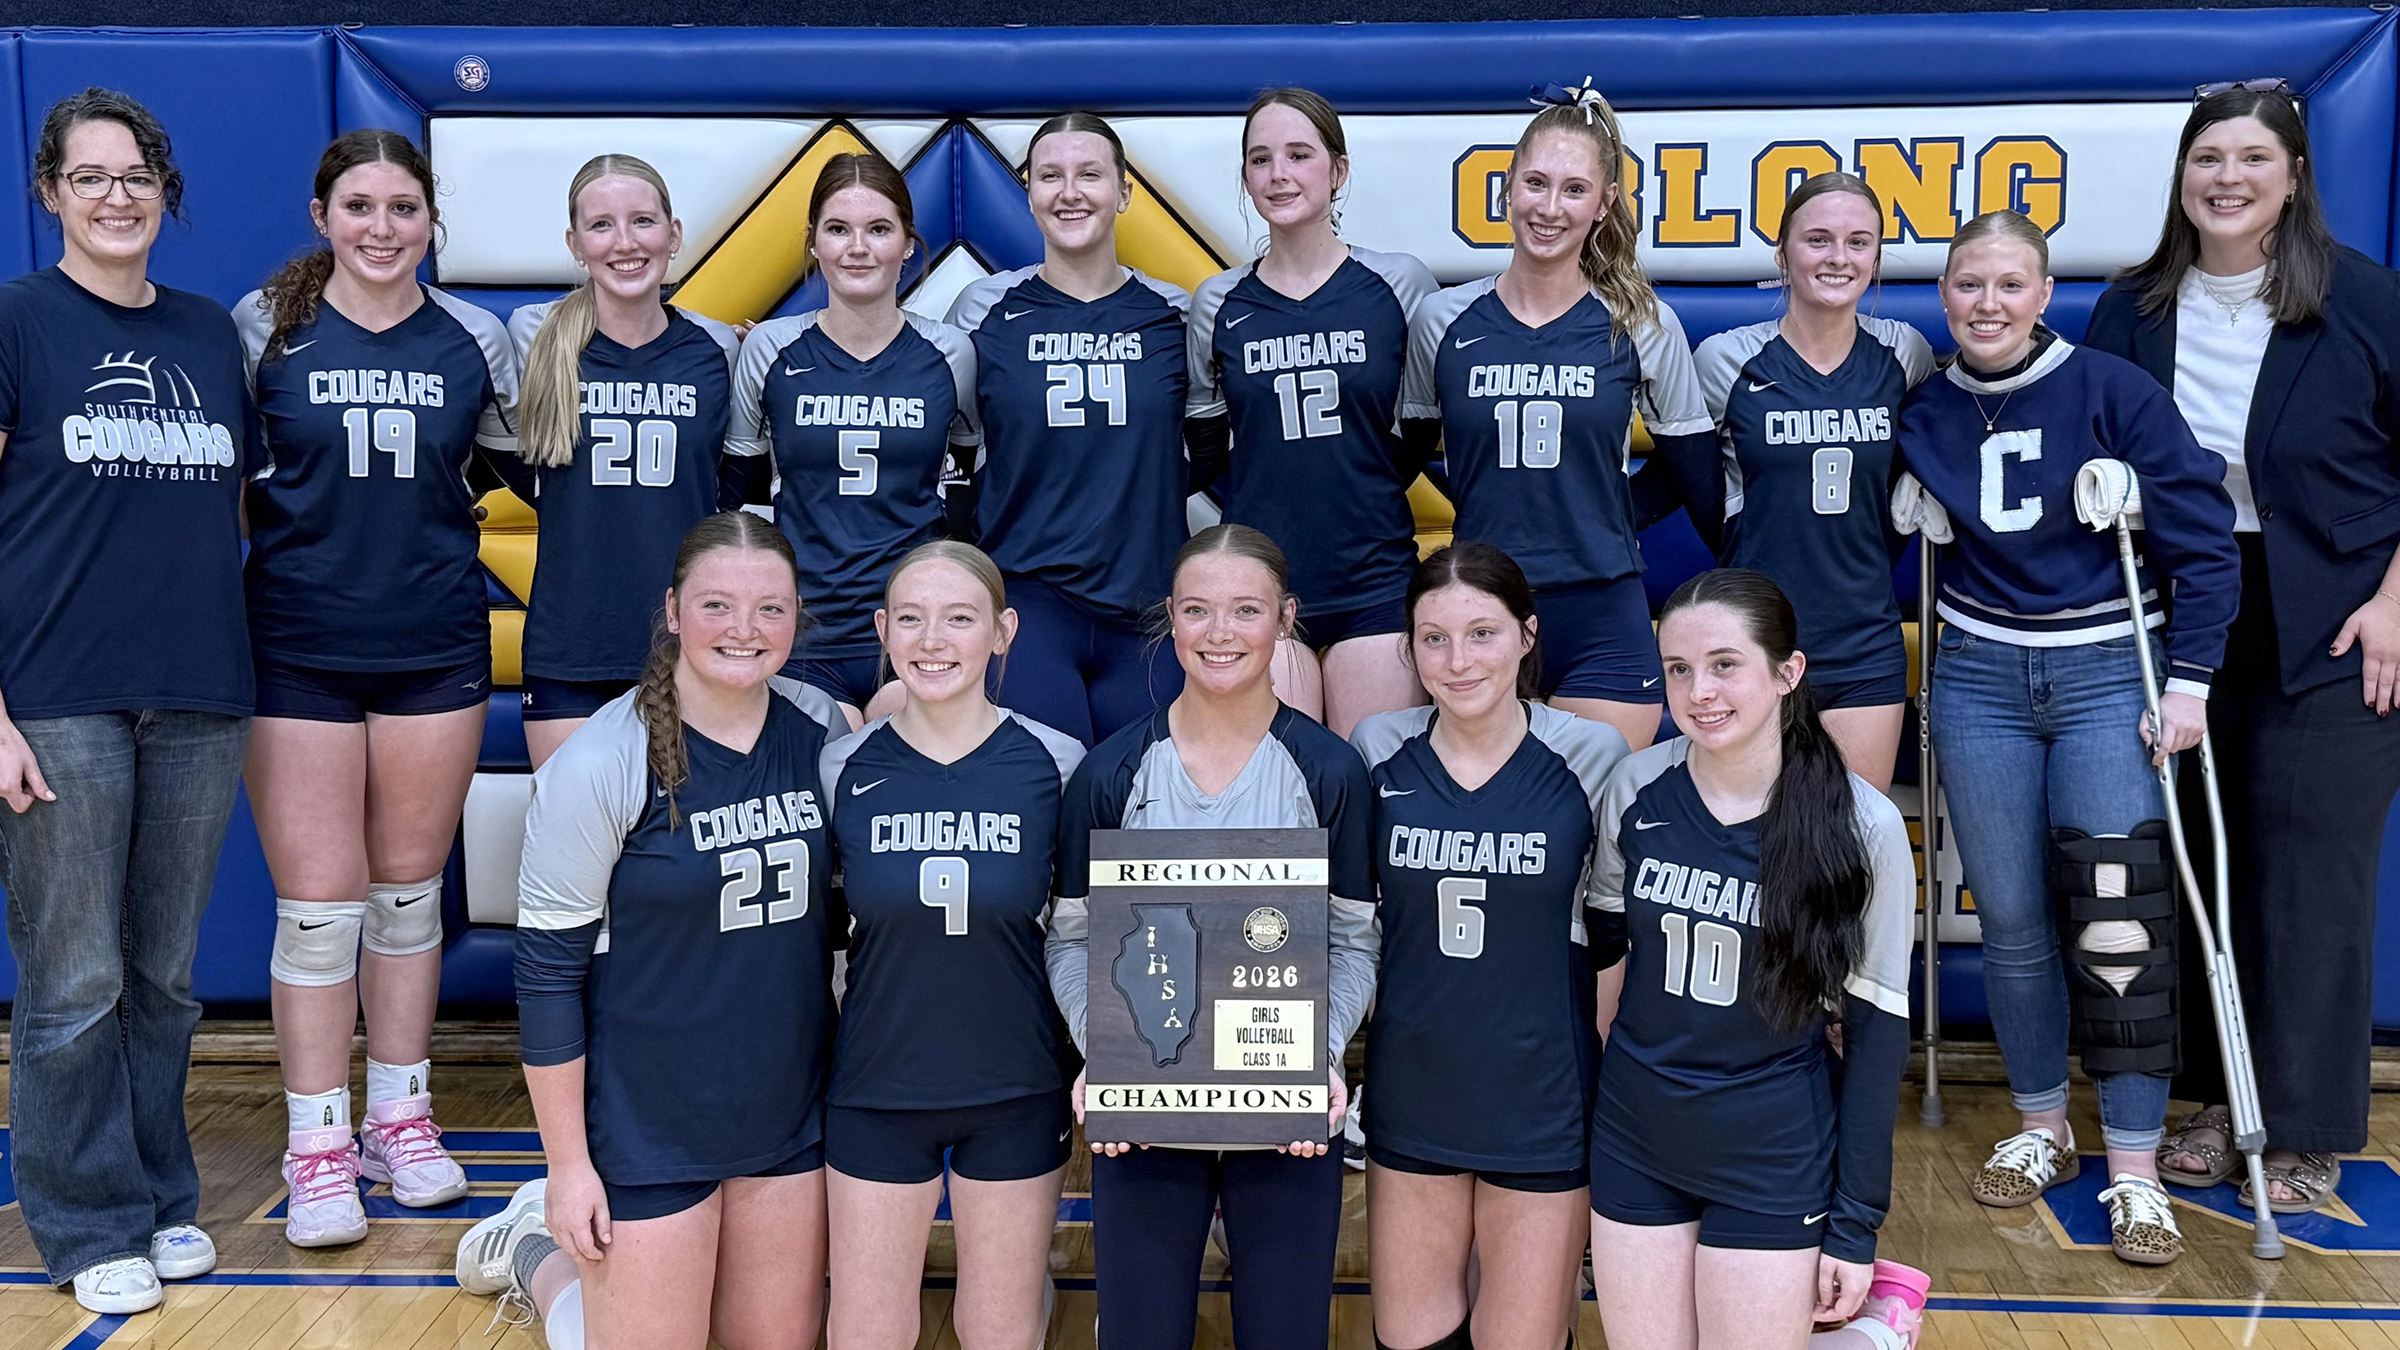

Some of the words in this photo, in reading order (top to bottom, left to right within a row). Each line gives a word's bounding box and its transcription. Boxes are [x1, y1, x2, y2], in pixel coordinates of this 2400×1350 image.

[1452, 135, 2067, 250] OLONG
[1028, 332, 1142, 361] COUGARS
[1244, 330, 1366, 374] COUGARS
[309, 370, 443, 407] COUGARS
[1047, 364, 1126, 426] 24
[1273, 369, 1342, 440] 12
[1469, 364, 1595, 398] COUGARS
[85, 403, 138, 419] SOUTH
[142, 406, 208, 424] CENTRAL
[796, 395, 924, 428] COUGARS
[1494, 401, 1562, 468] 18
[1766, 407, 1890, 444] COUGARS
[62, 415, 235, 467] COUGARS
[343, 408, 415, 478] 19
[591, 419, 677, 487] 20
[838, 430, 880, 496] 5
[91, 463, 219, 482] VOLLEYBALL
[1812, 448, 1853, 515] 8
[1980, 428, 2043, 533] C
[690, 789, 823, 852] COUGARS
[871, 812, 1020, 853] COUGARS
[1117, 863, 1300, 882] REGIONAL
[1389, 825, 1546, 874] COUGARS
[719, 838, 809, 933] 23
[919, 857, 969, 935] 9
[1633, 857, 1764, 928] COUGAR
[1437, 877, 1486, 958] 6
[1232, 965, 1298, 988] 2026
[1661, 912, 1741, 1006] 10
[1236, 1027, 1295, 1044] VOLLEYBALL
[1252, 1006, 1280, 1023] GIRLS
[1243, 1052, 1270, 1067] CLASS
[1276, 1053, 1287, 1067] 1A
[1099, 1089, 1312, 1108] CHAMPIONS
